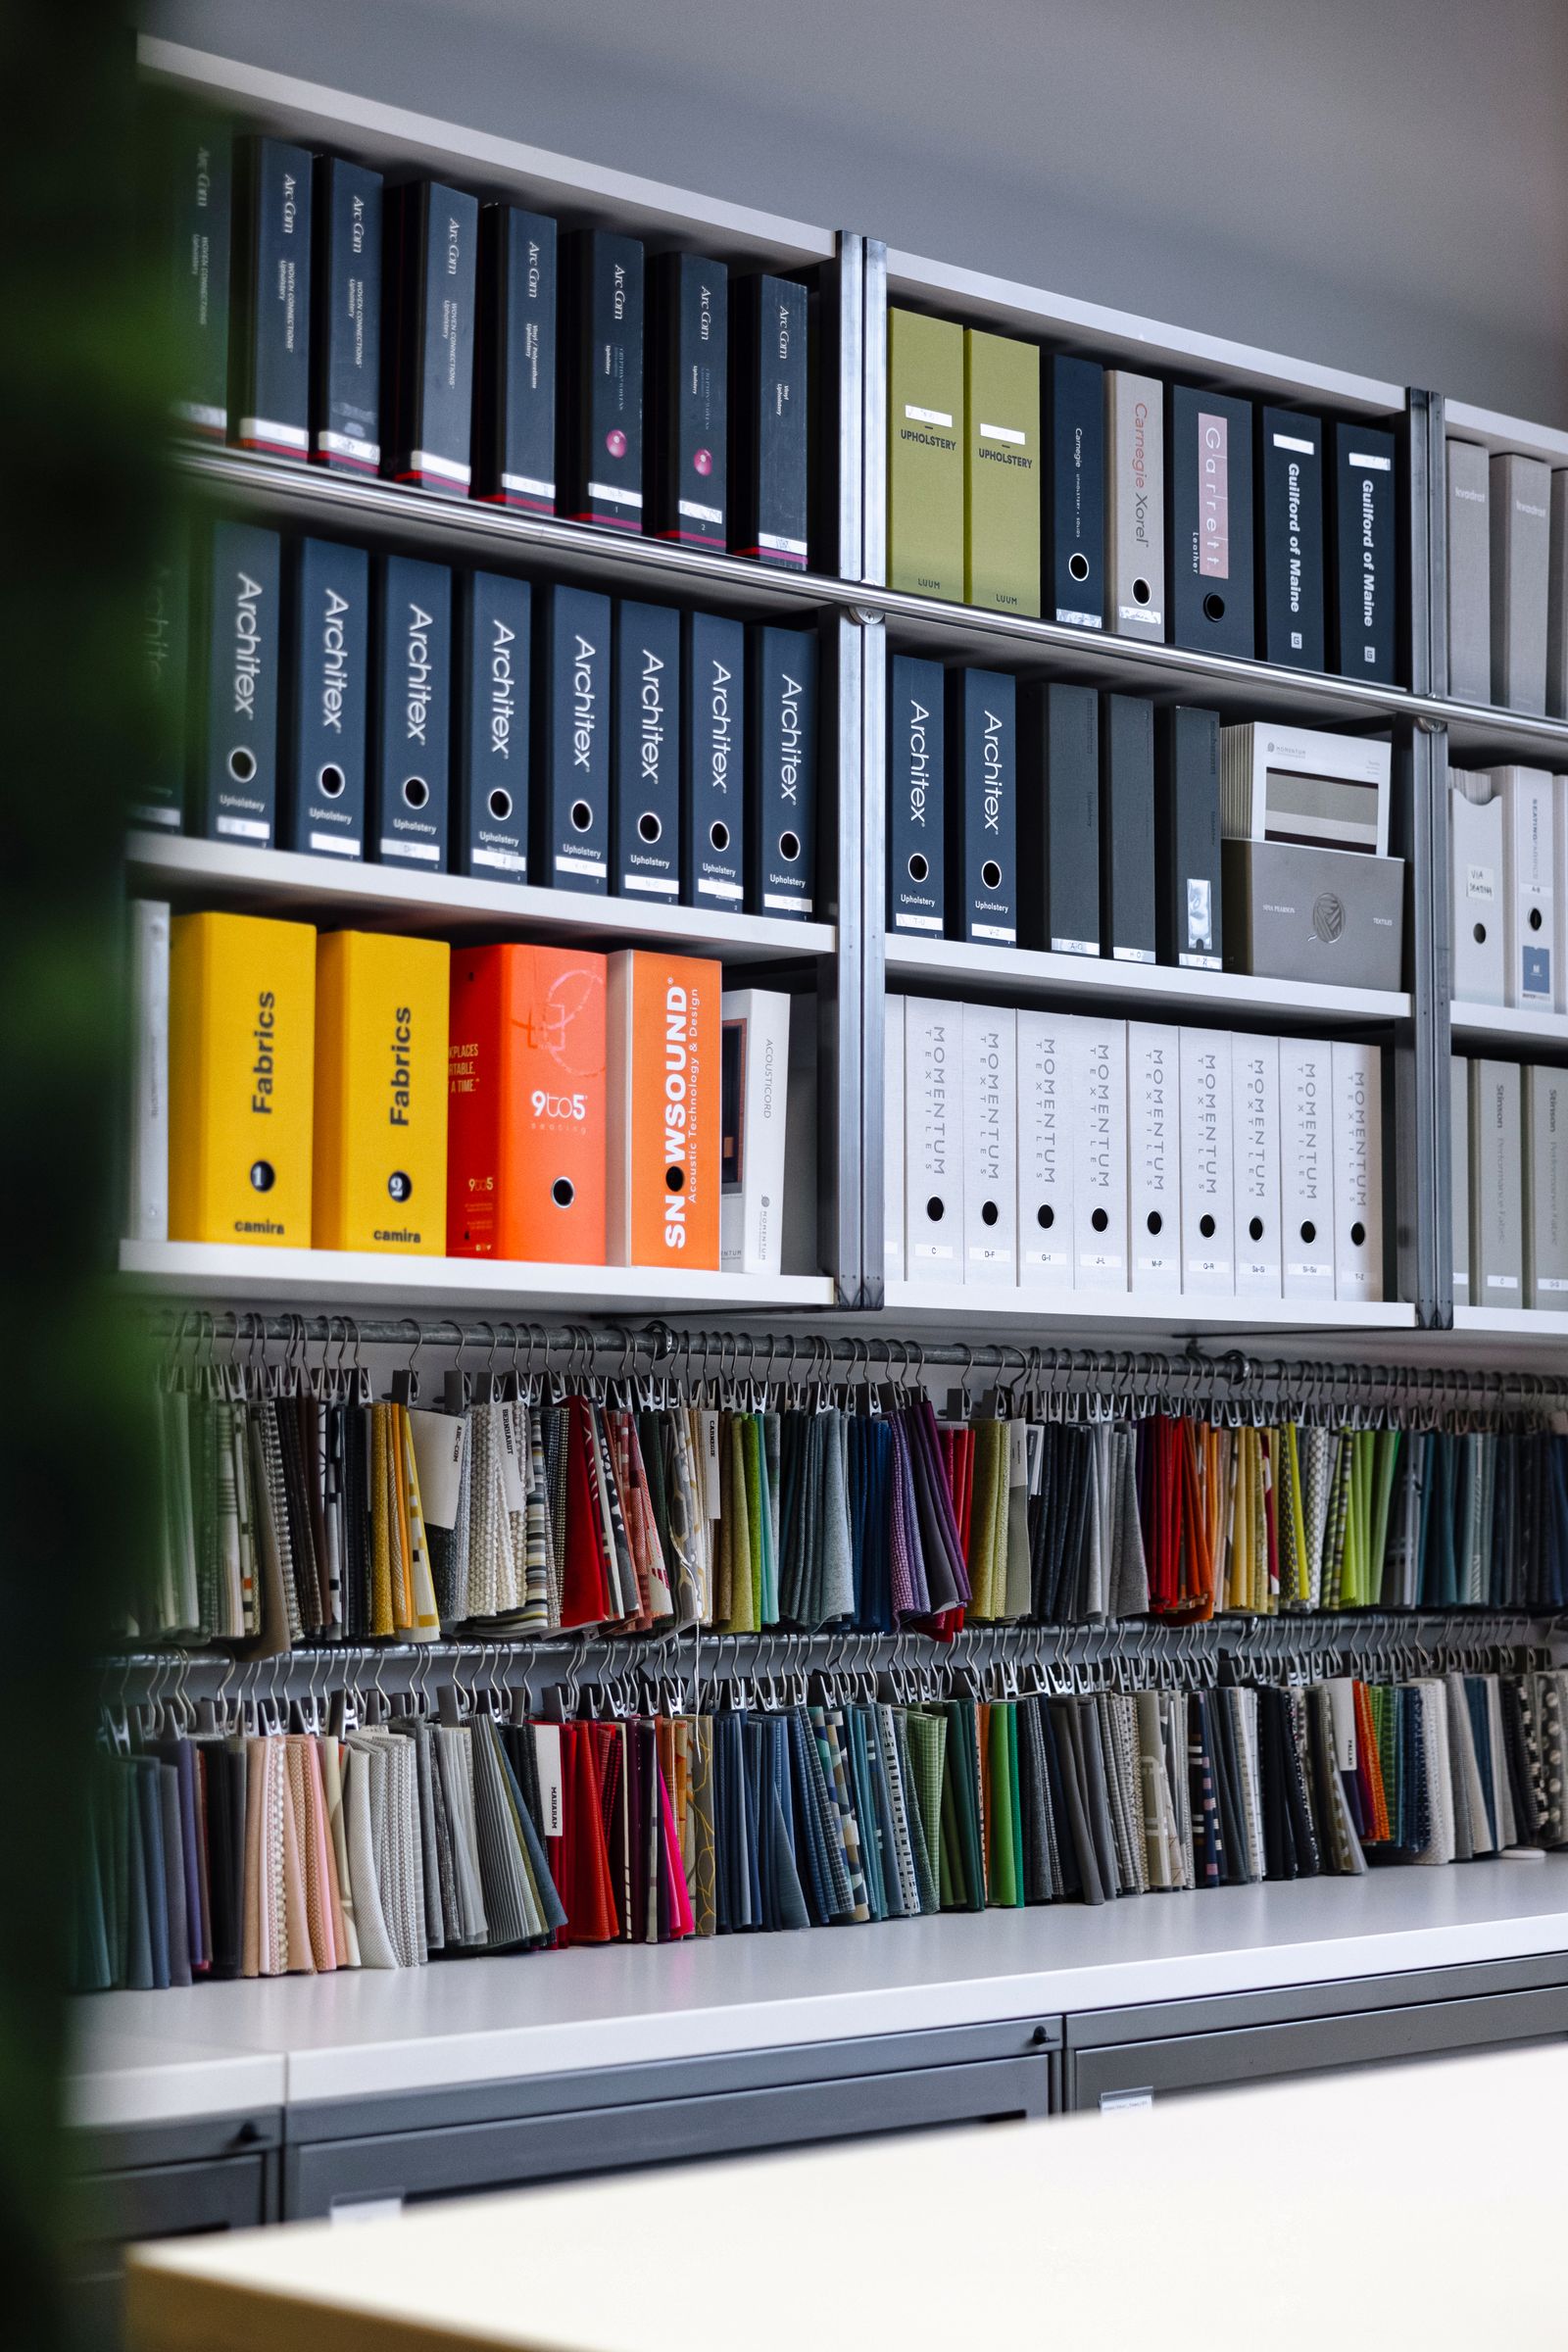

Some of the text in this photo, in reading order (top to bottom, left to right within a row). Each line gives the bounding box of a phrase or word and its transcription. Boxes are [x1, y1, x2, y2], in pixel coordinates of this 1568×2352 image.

[282, 173, 296, 233] Arc Com
[352, 196, 366, 253] Arc Com
[448, 219, 460, 274] Arc Com
[529, 241, 540, 298] Arc Com
[614, 265, 625, 320] Arc Com
[701, 286, 711, 341] Arc Com
[780, 306, 790, 327] Arc
[901, 429, 956, 451] UPHOLSTERY
[979, 448, 1032, 468] UPHOLSTERY
[1074, 428, 1083, 468] Carnegie
[1133, 404, 1149, 544] Carnegie Xorel
[1205, 426, 1221, 570] Garrett
[1455, 486, 1486, 502] kvadrat
[1516, 500, 1546, 517] kvadrat
[1288, 464, 1301, 613] Guilford of Maine
[1362, 480, 1374, 627] Guilford of Maine
[917, 578, 940, 590] LUUM
[996, 593, 1017, 606] LUUM
[233, 572, 263, 714] Architex
[322, 589, 349, 728] Architex
[407, 604, 433, 741] Architex
[492, 619, 515, 752] Architex
[573, 635, 596, 766] Architex
[641, 649, 664, 778] Architex
[711, 660, 731, 788] Architex
[780, 674, 803, 800] Architex
[909, 700, 930, 823] Architex
[983, 710, 1004, 831] Architex
[220, 794, 266, 812] Upholstery
[309, 808, 353, 825] Upholstery
[393, 818, 437, 835] Upholstery
[479, 831, 519, 847] Upholstery
[563, 843, 601, 859] Upholstery
[630, 855, 670, 868] Upholstery
[703, 862, 736, 877] Upholstery
[769, 873, 806, 888] Upholstery
[1471, 870, 1483, 880] VIA
[900, 894, 936, 907] Upholstery
[975, 900, 1008, 913] Upholstery
[253, 991, 275, 1114] Fabrics
[390, 1006, 412, 1126] Fabrics
[763, 1038, 772, 1119] ACOUSTICORD
[531, 1091, 586, 1120] 9to5
[688, 988, 700, 1203] Acoustic Technology & Design
[934, 1027, 945, 1174] MOMENTUM
[988, 1033, 999, 1179] MOMENTUM
[1044, 1039, 1054, 1183] MOMENTUM
[1099, 1045, 1108, 1187] MOMENTUM
[1153, 1050, 1163, 1190] MOMENTUM
[1205, 1055, 1216, 1194] MOMENTUM
[1254, 1060, 1264, 1197] MOMENTUM
[1305, 1064, 1316, 1199] MOMENTUM
[1354, 1072, 1366, 1205] MOMENTUM
[390, 1178, 404, 1197] 2
[235, 1219, 284, 1235] camira
[373, 1228, 421, 1244] camira
[502, 1409, 514, 1455] BERNHARDT
